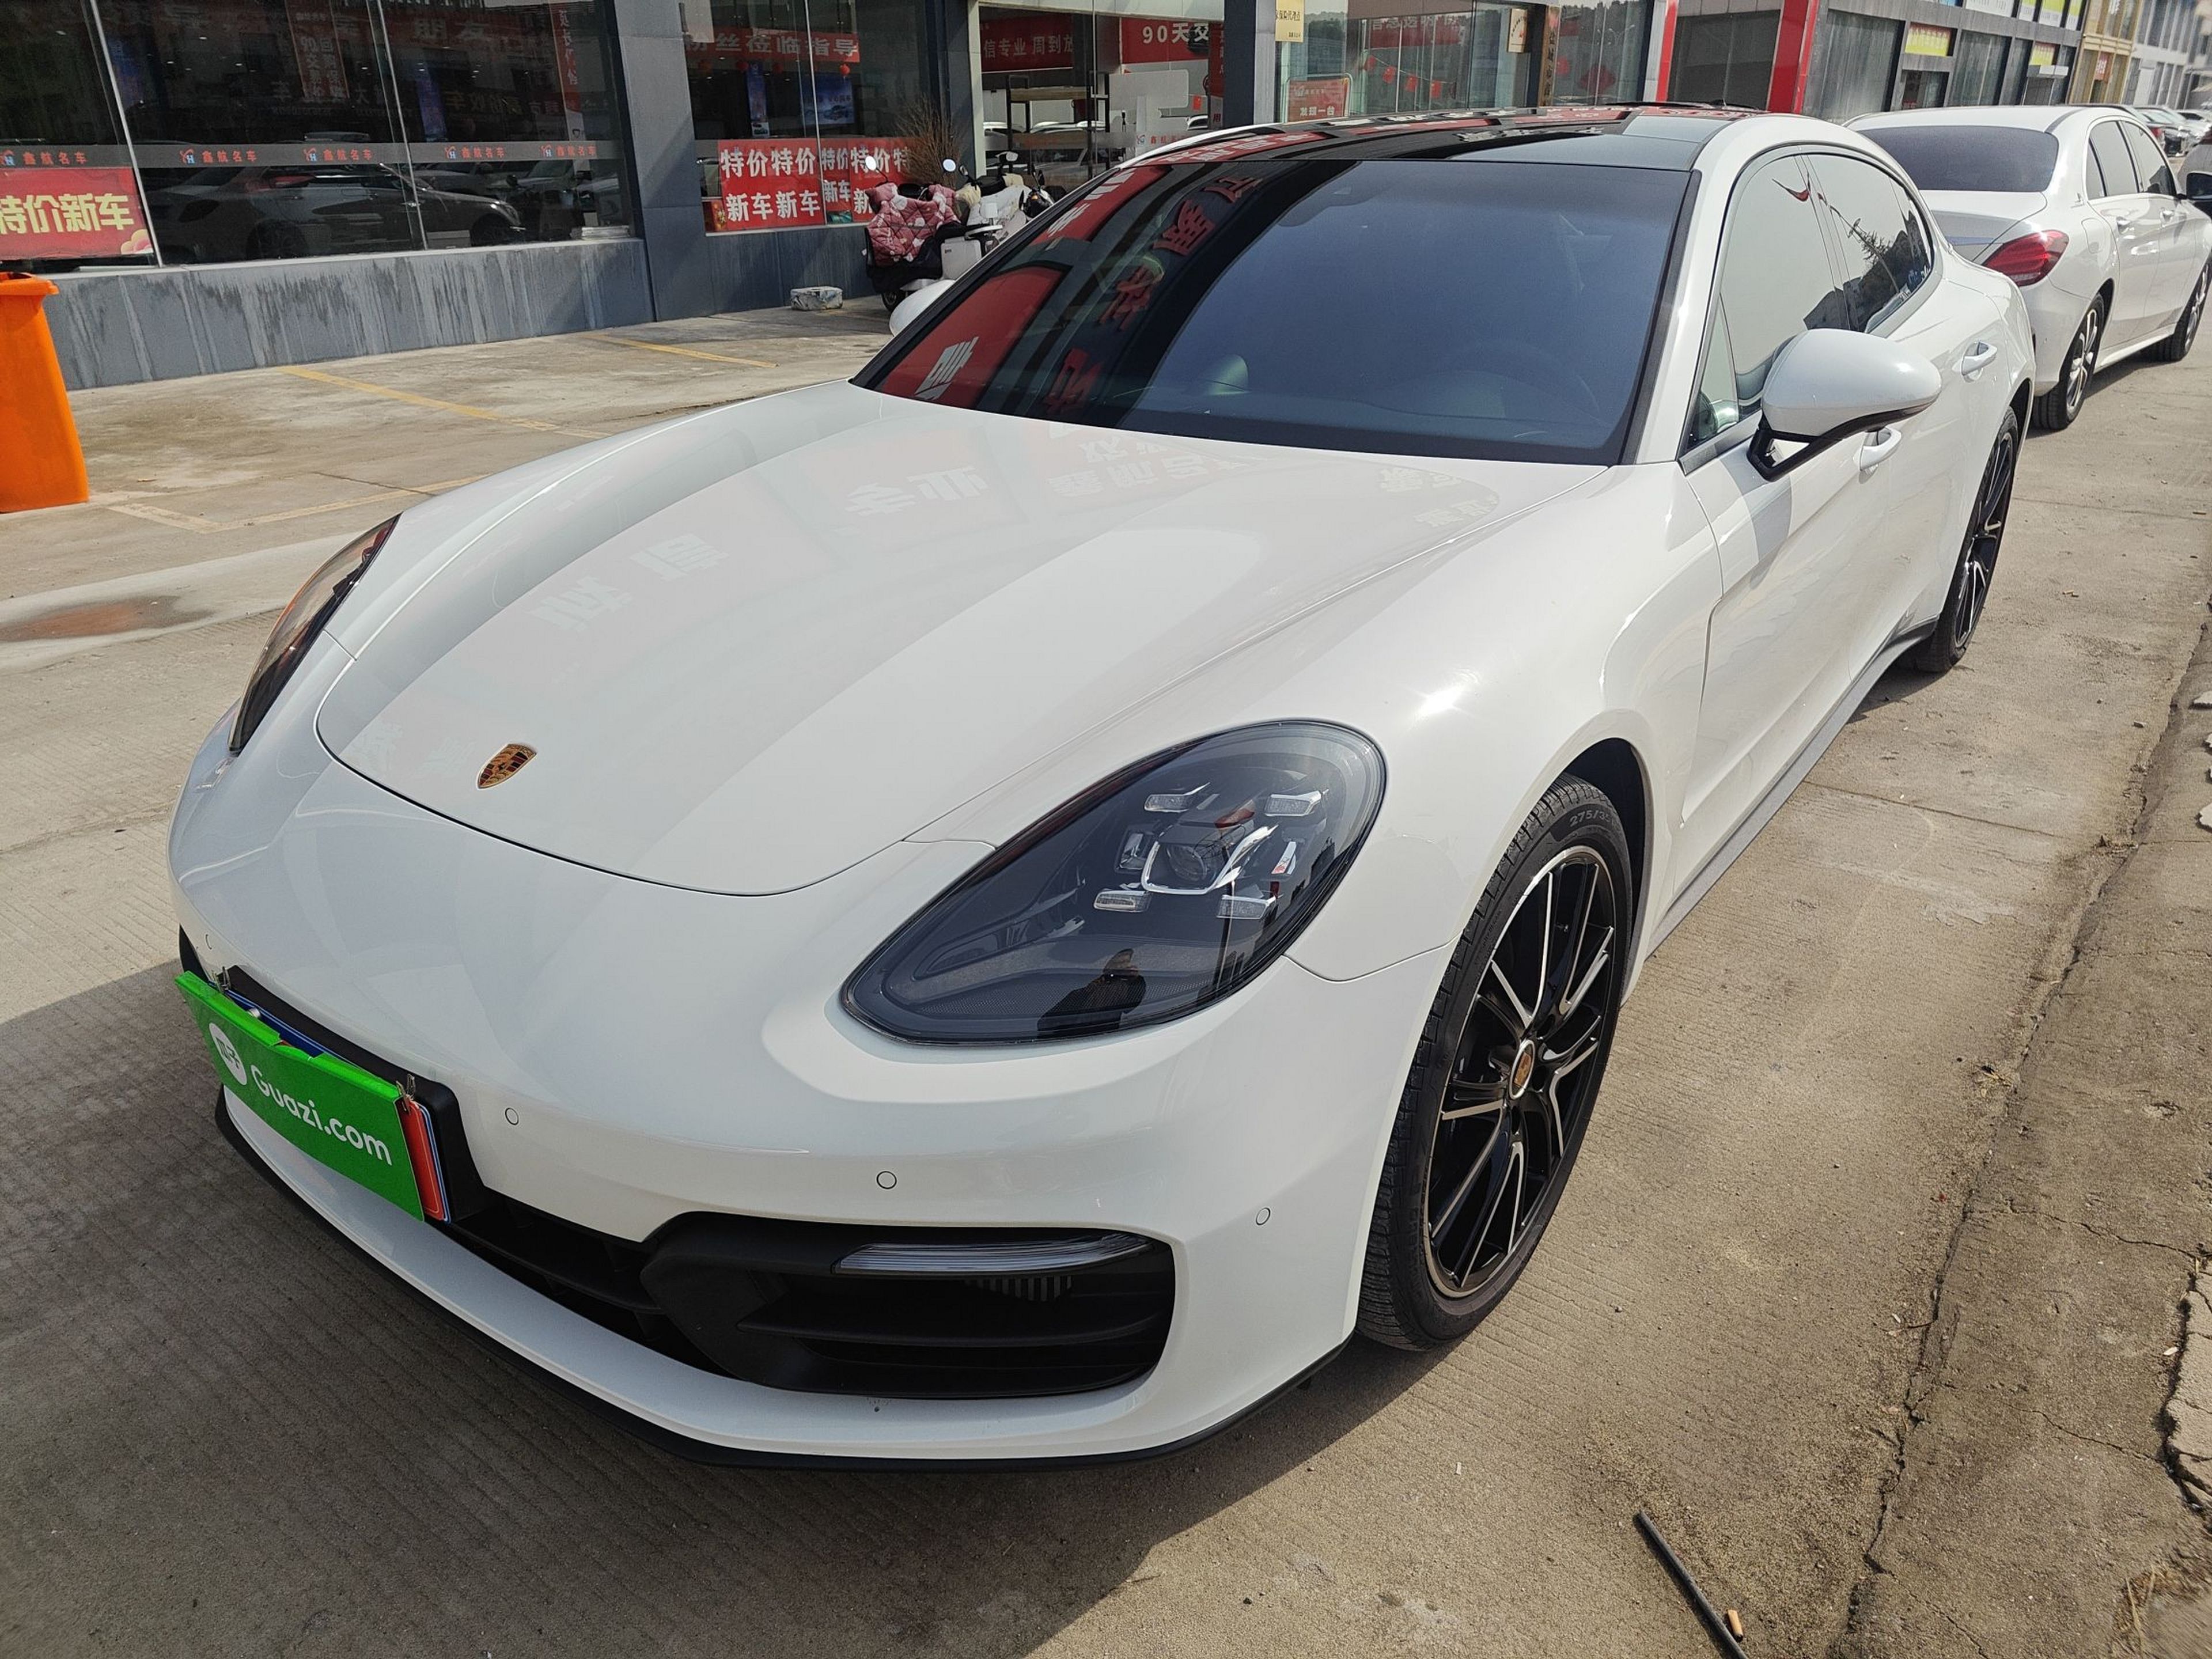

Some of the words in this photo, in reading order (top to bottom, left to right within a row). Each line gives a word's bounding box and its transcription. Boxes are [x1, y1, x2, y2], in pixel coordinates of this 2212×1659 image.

[721, 146, 817, 179] 特价特价
[0, 193, 134, 235] 特价新车
[726, 190, 821, 223] 新车新车
[250, 1064, 393, 1166] Guazi.com
